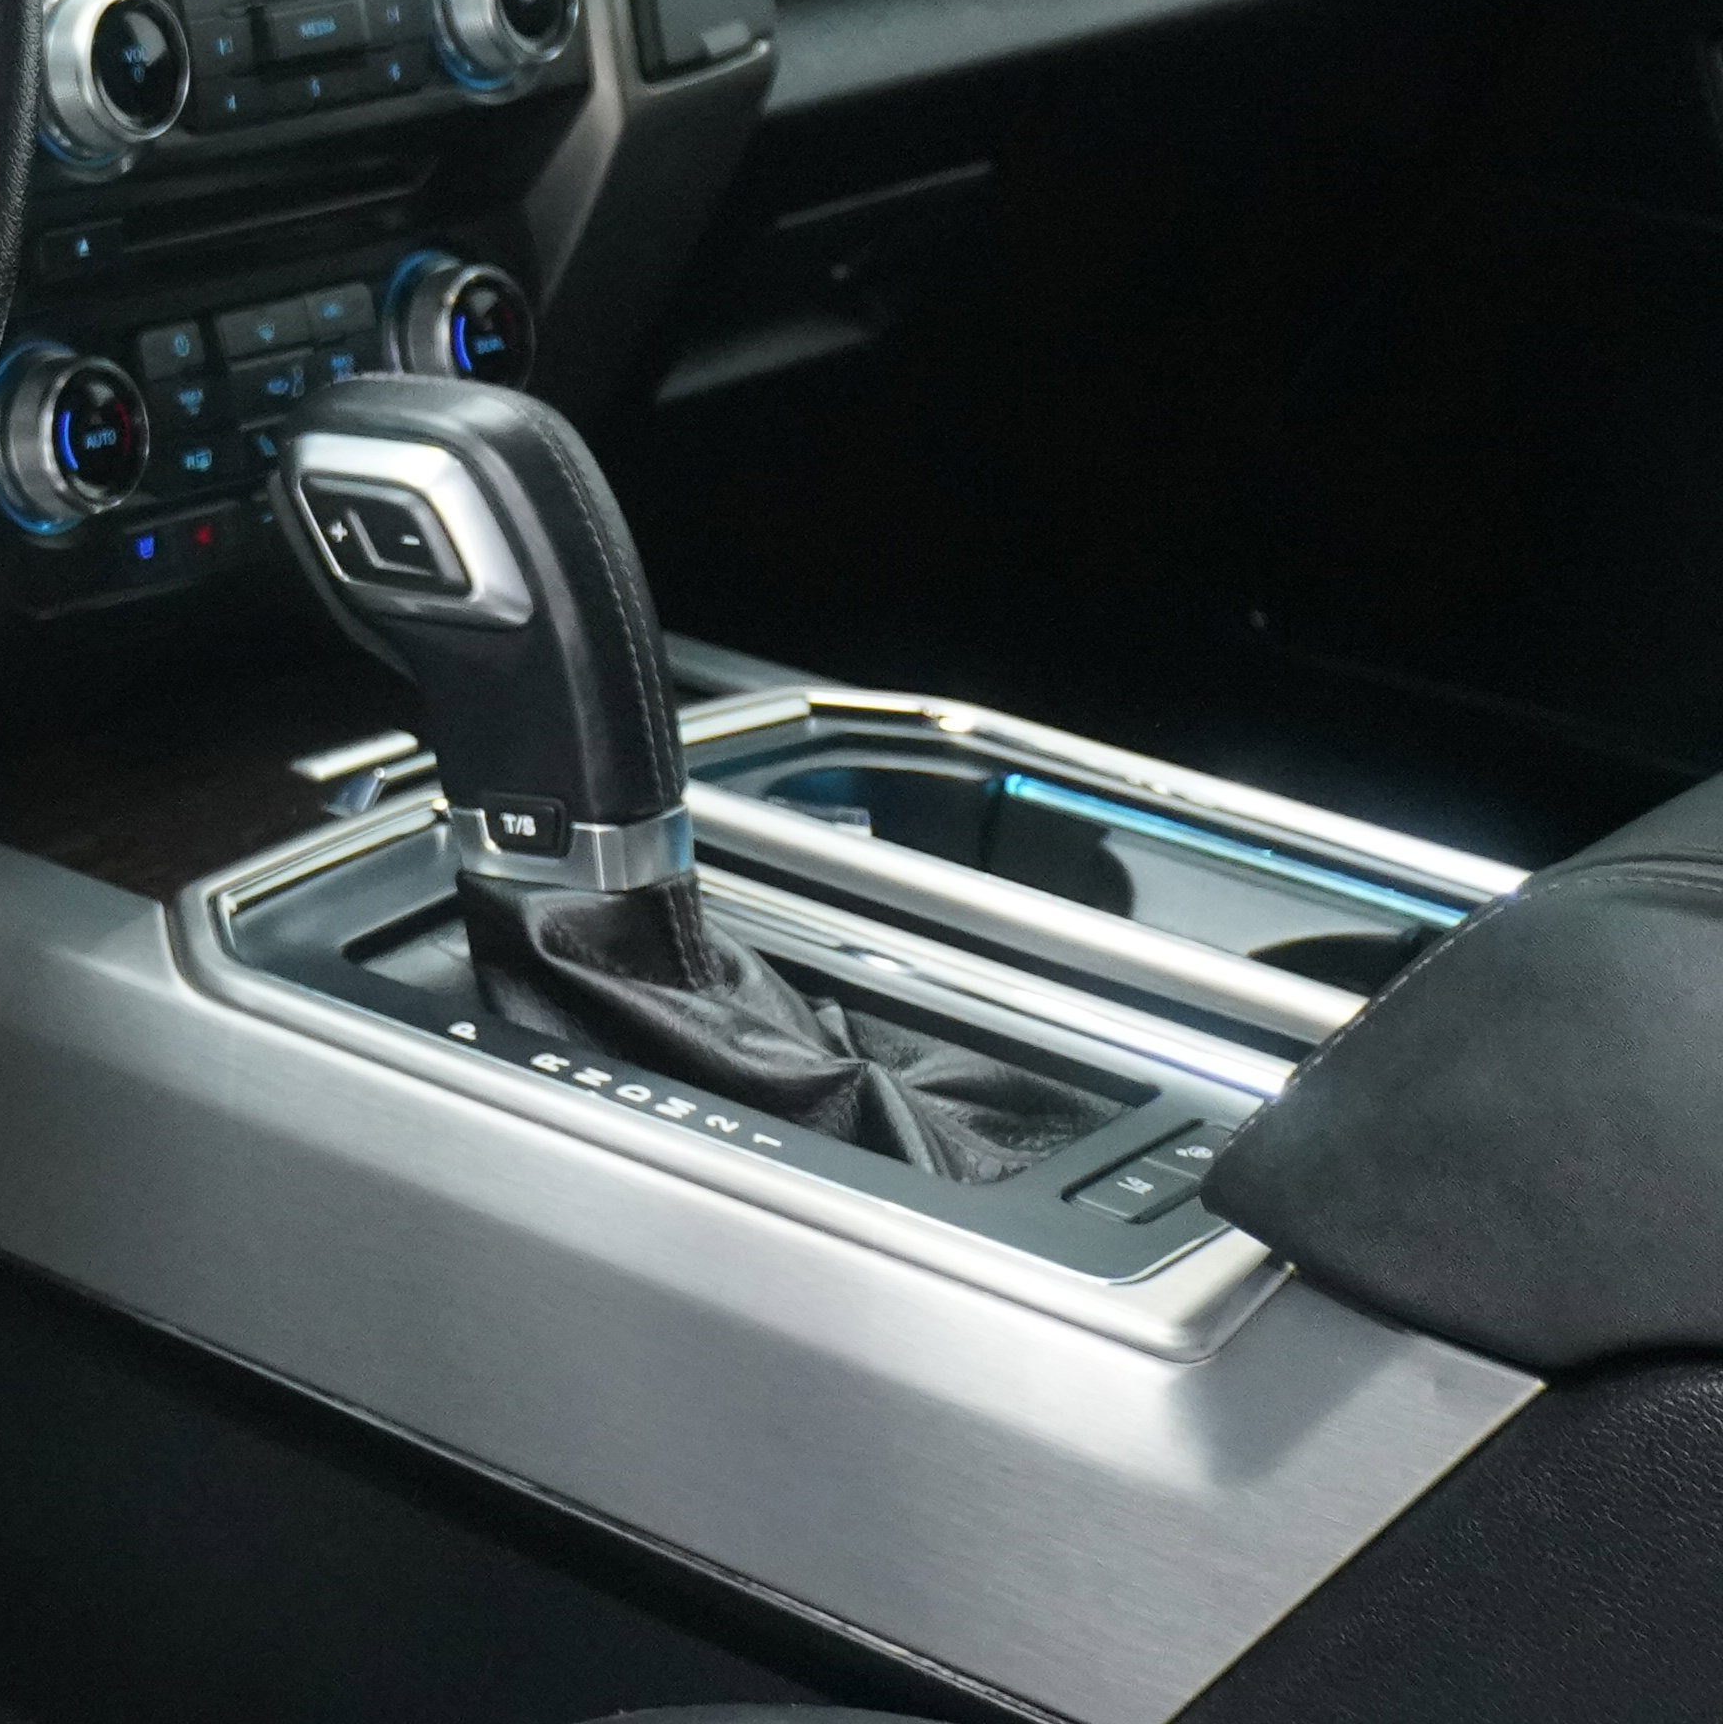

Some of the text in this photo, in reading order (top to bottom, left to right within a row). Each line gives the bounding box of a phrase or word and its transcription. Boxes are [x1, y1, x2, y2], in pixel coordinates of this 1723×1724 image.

[84, 427, 117, 450] AUTO
[446, 1020, 783, 1149] P R N D M 2 1
